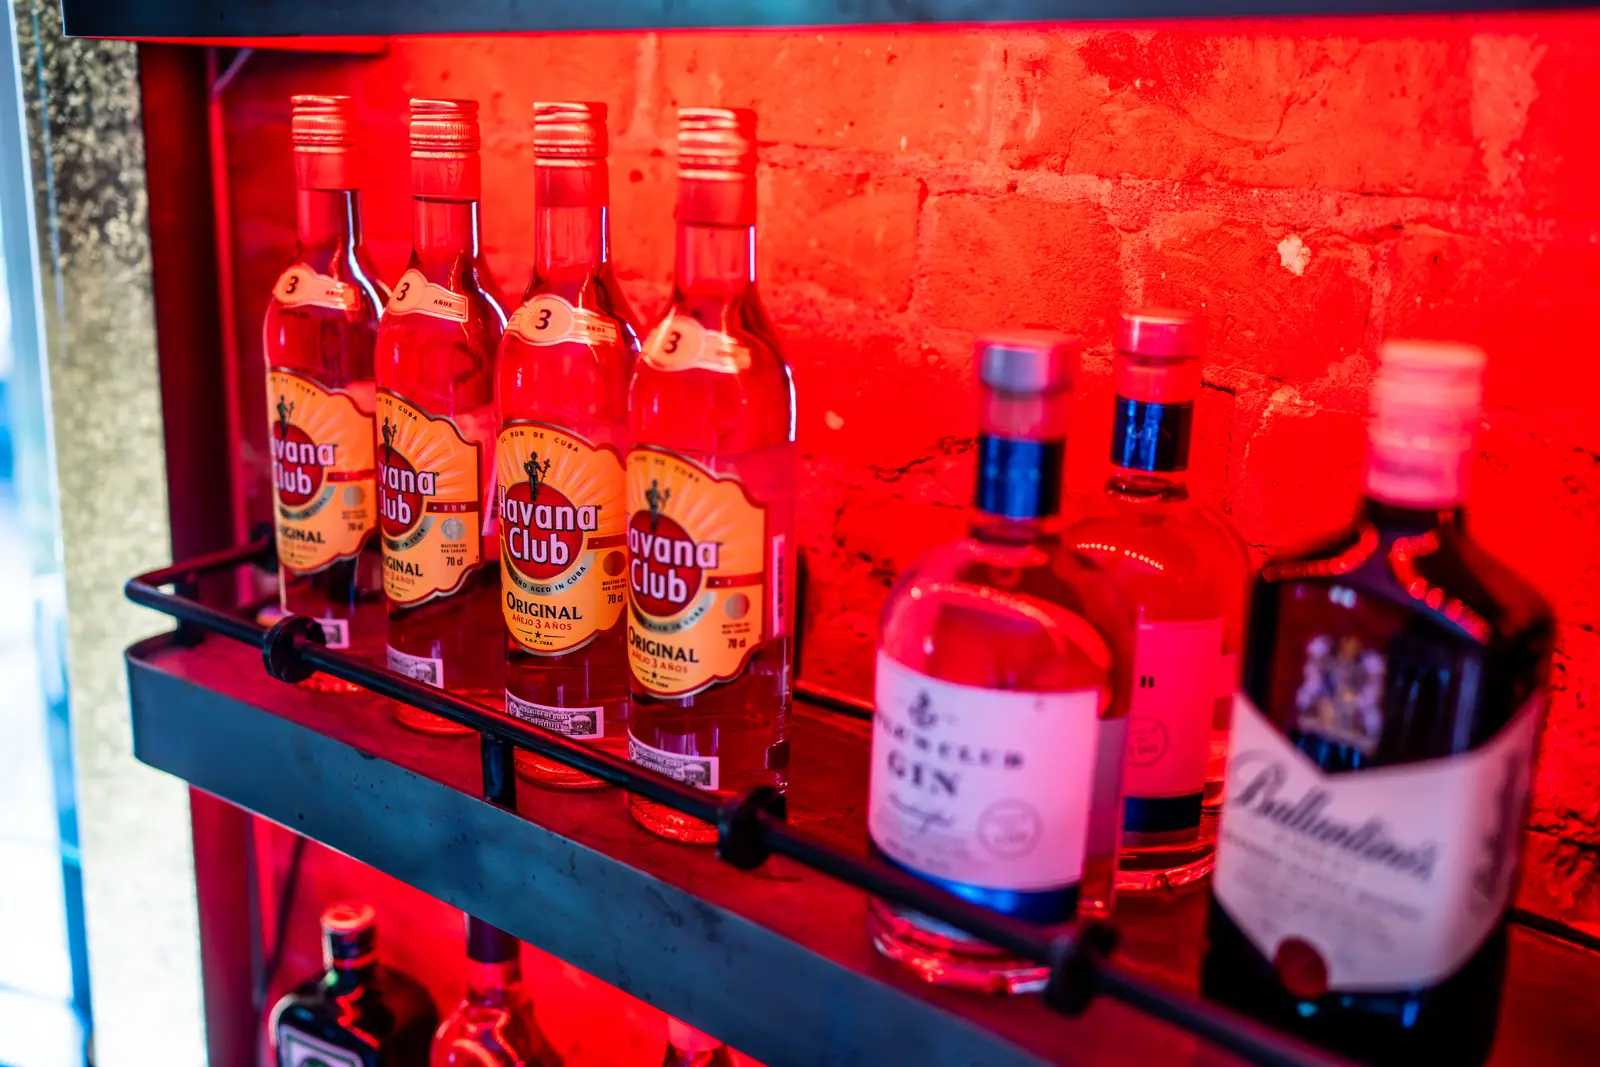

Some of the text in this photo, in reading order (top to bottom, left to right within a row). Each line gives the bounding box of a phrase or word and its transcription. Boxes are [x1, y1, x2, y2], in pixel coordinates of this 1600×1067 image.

[286, 276, 299, 294] 3
[396, 282, 453, 308] 3 AÑOS
[535, 309, 552, 330] 3
[664, 331, 681, 354] 3
[398, 405, 418, 421] CUBA
[533, 431, 544, 439] DE
[554, 437, 579, 453] CUBA
[509, 526, 569, 566] Club
[627, 515, 719, 569] avana
[446, 556, 455, 566] 70
[555, 583, 564, 591] IN
[567, 566, 586, 585] CUBA
[631, 558, 688, 604] Club
[506, 591, 583, 621] ORIGINAL
[607, 593, 616, 604] 70
[512, 612, 572, 631] AÑEJO 3 AÑOS
[629, 625, 699, 663] ORIGINAL
[887, 750, 960, 795] GIN
